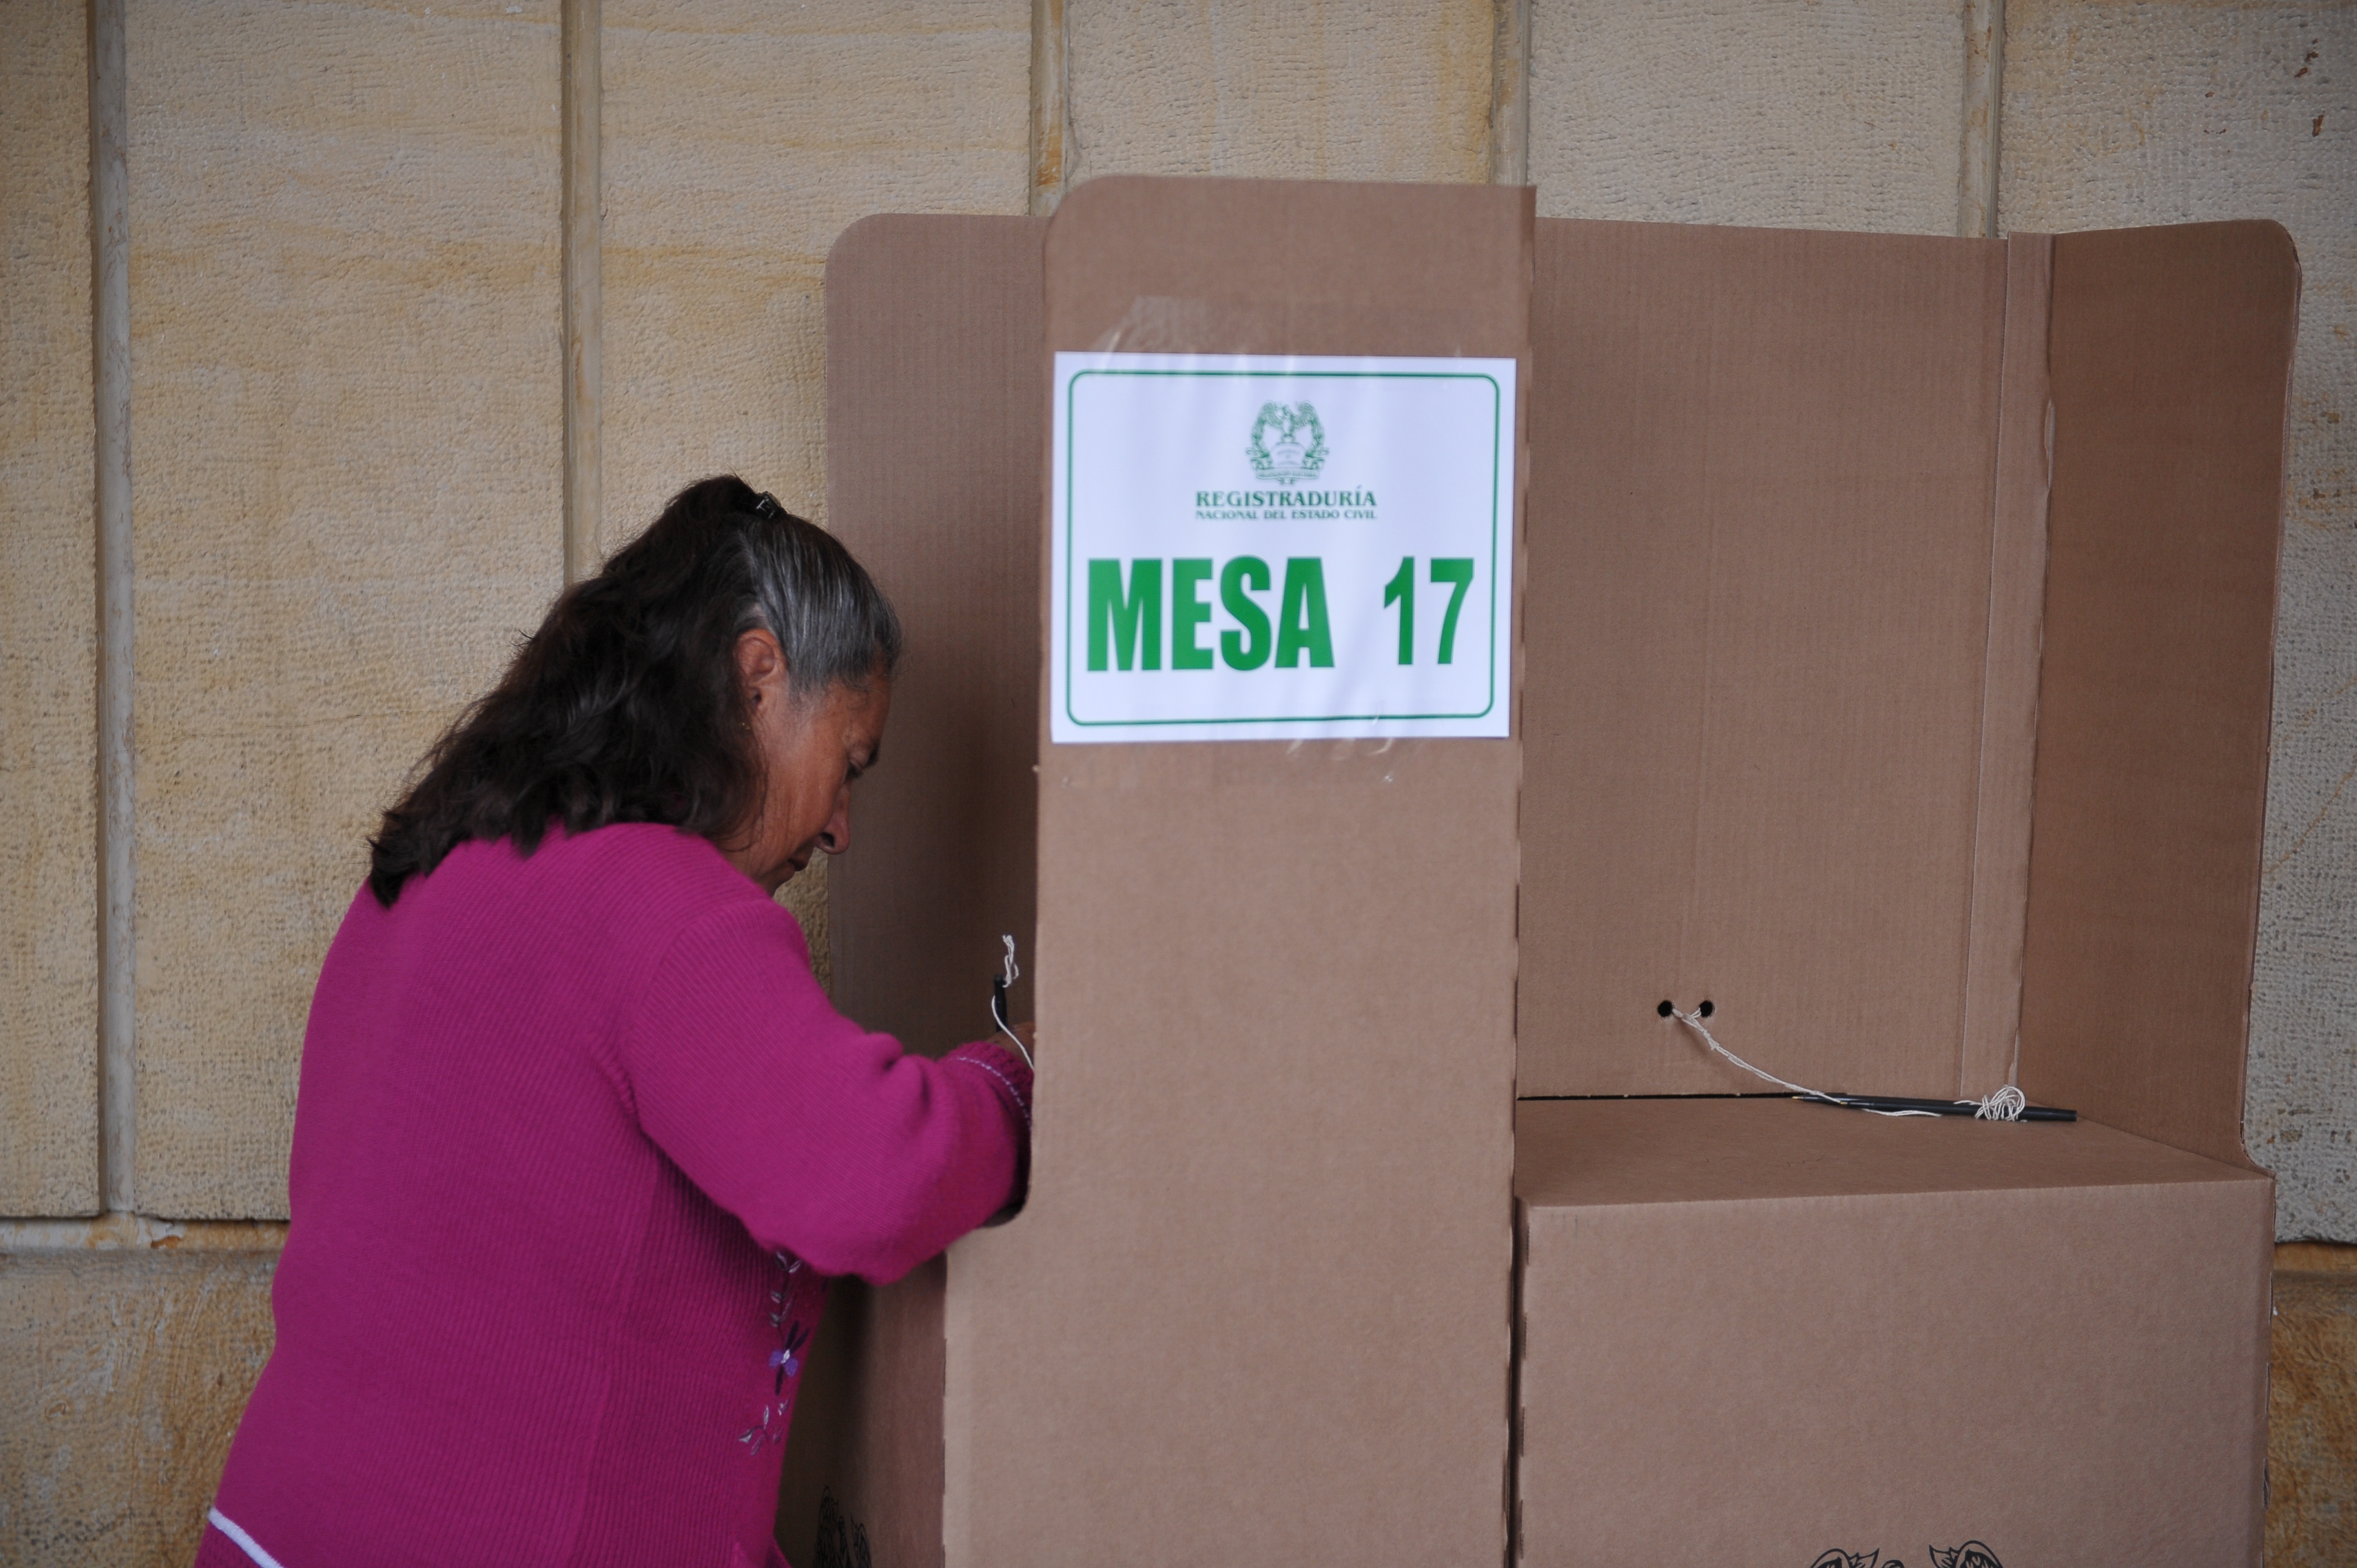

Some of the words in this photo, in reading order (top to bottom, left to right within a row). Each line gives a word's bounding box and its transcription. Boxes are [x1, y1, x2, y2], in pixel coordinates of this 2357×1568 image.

[1196, 484, 1377, 507] REGISTRADURÍA
[1196, 509, 1259, 519] NACIONAL
[1264, 509, 1286, 519] DEL
[1291, 509, 1340, 519] ESTADO
[1344, 509, 1377, 519] CIVIL
[1087, 555, 1335, 672] MESA
[1383, 555, 1475, 666] 17
